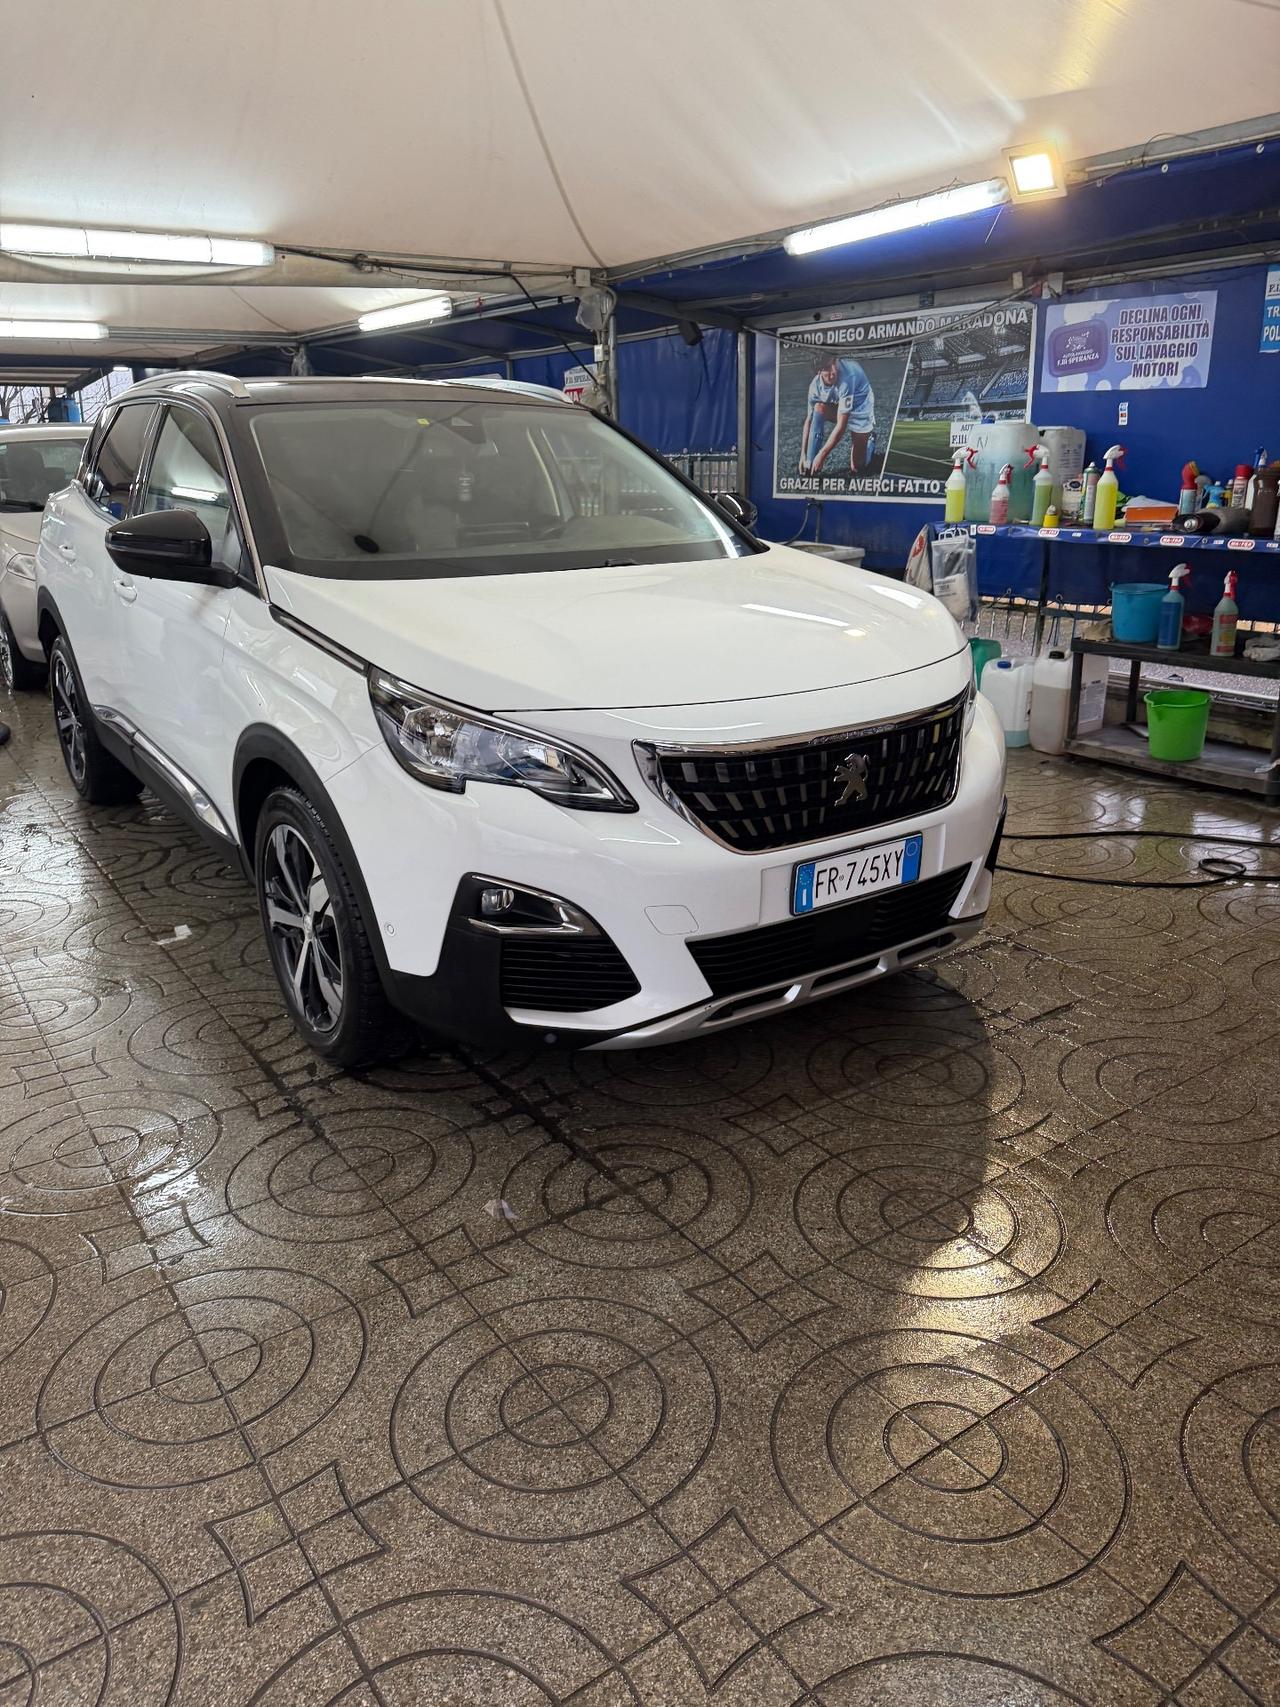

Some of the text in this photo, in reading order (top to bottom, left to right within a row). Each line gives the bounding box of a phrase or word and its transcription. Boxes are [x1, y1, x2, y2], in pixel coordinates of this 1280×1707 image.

[1120, 304, 1202, 325] DECLINA OGNI
[827, 327, 865, 344] DIEGO
[867, 319, 935, 341] ARMANDO
[1111, 320, 1210, 343] RESPONSABILITÀ
[1069, 352, 1100, 365] SPERANZA
[1116, 342, 1198, 361] SUL LAVAGGIO
[1132, 361, 1179, 378] MOTORI
[779, 477, 941, 494] GRAZIE PER AVERCI FATTO
[815, 867, 839, 899] FR
[845, 848, 904, 891] 745XY
